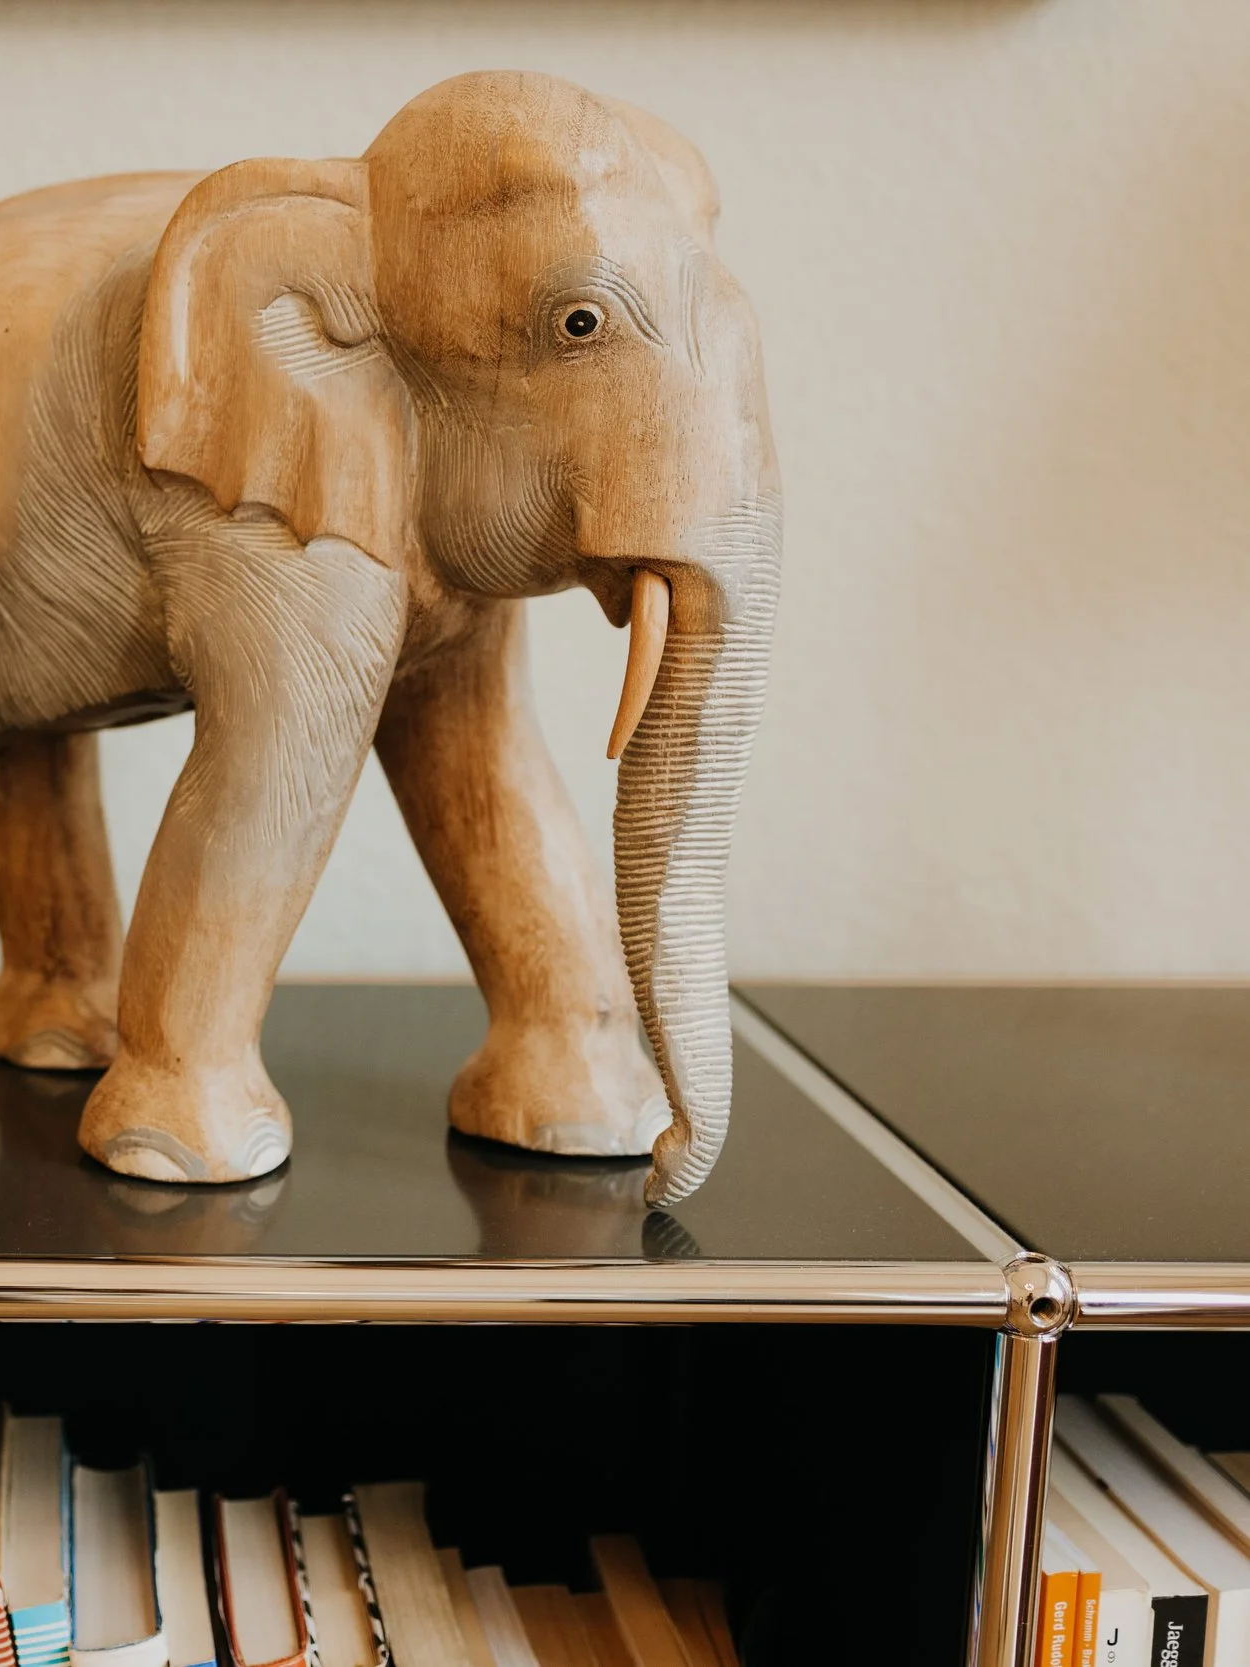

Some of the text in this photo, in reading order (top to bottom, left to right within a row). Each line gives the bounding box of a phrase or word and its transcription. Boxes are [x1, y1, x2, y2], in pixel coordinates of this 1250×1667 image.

[1053, 1601, 1068, 1631] Gerd
[1083, 1599, 1097, 1642] Schramm
[1107, 1628, 1118, 1646] J
